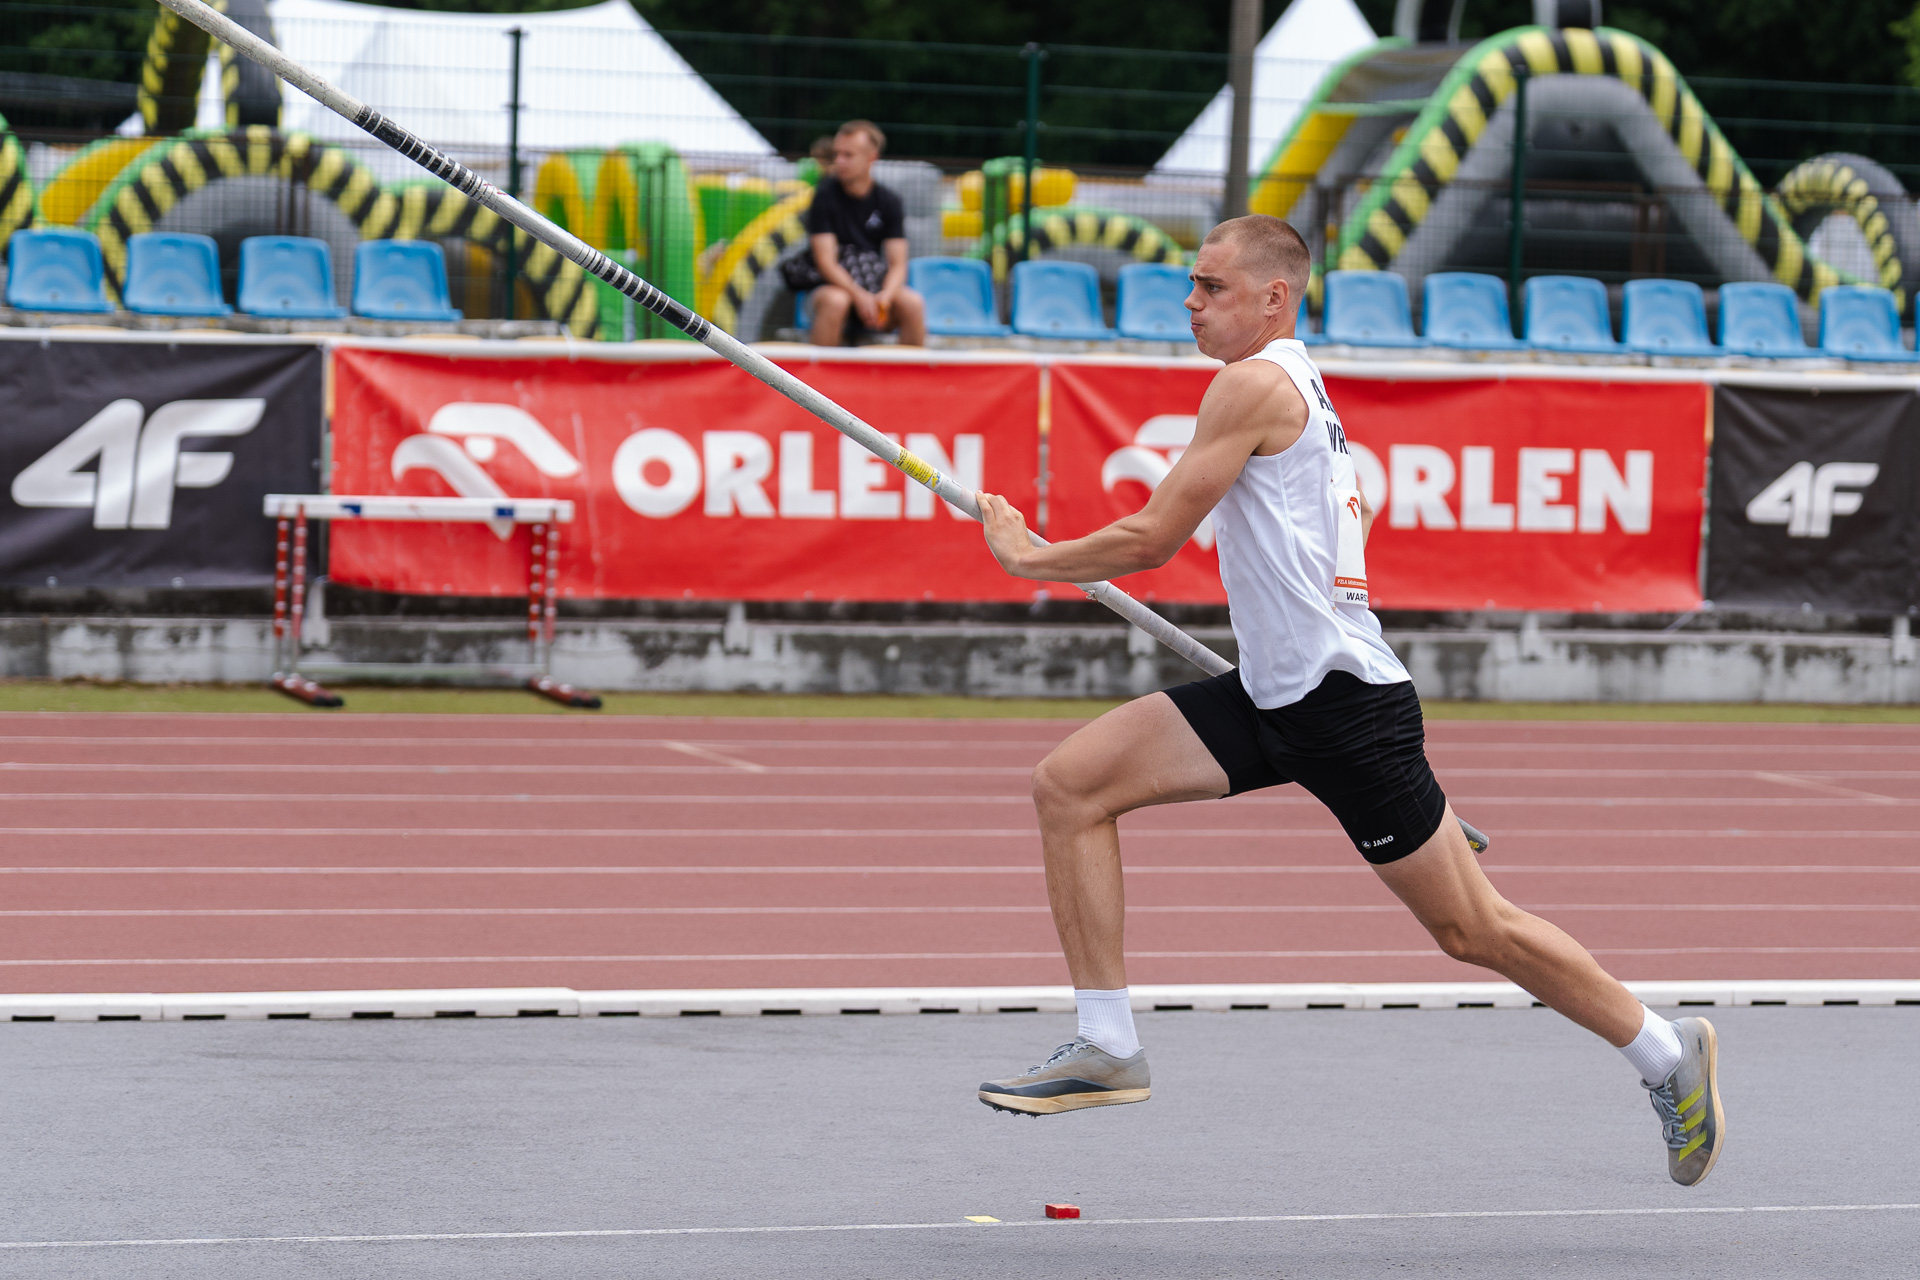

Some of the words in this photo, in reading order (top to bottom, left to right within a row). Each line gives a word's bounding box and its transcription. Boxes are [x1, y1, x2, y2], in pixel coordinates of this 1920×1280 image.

[11, 398, 266, 529] 4F
[612, 427, 984, 520] ORLEN
[1325, 421, 1352, 457] WR
[1745, 461, 1879, 538] 4F
[1373, 835, 1394, 847] JAKO
